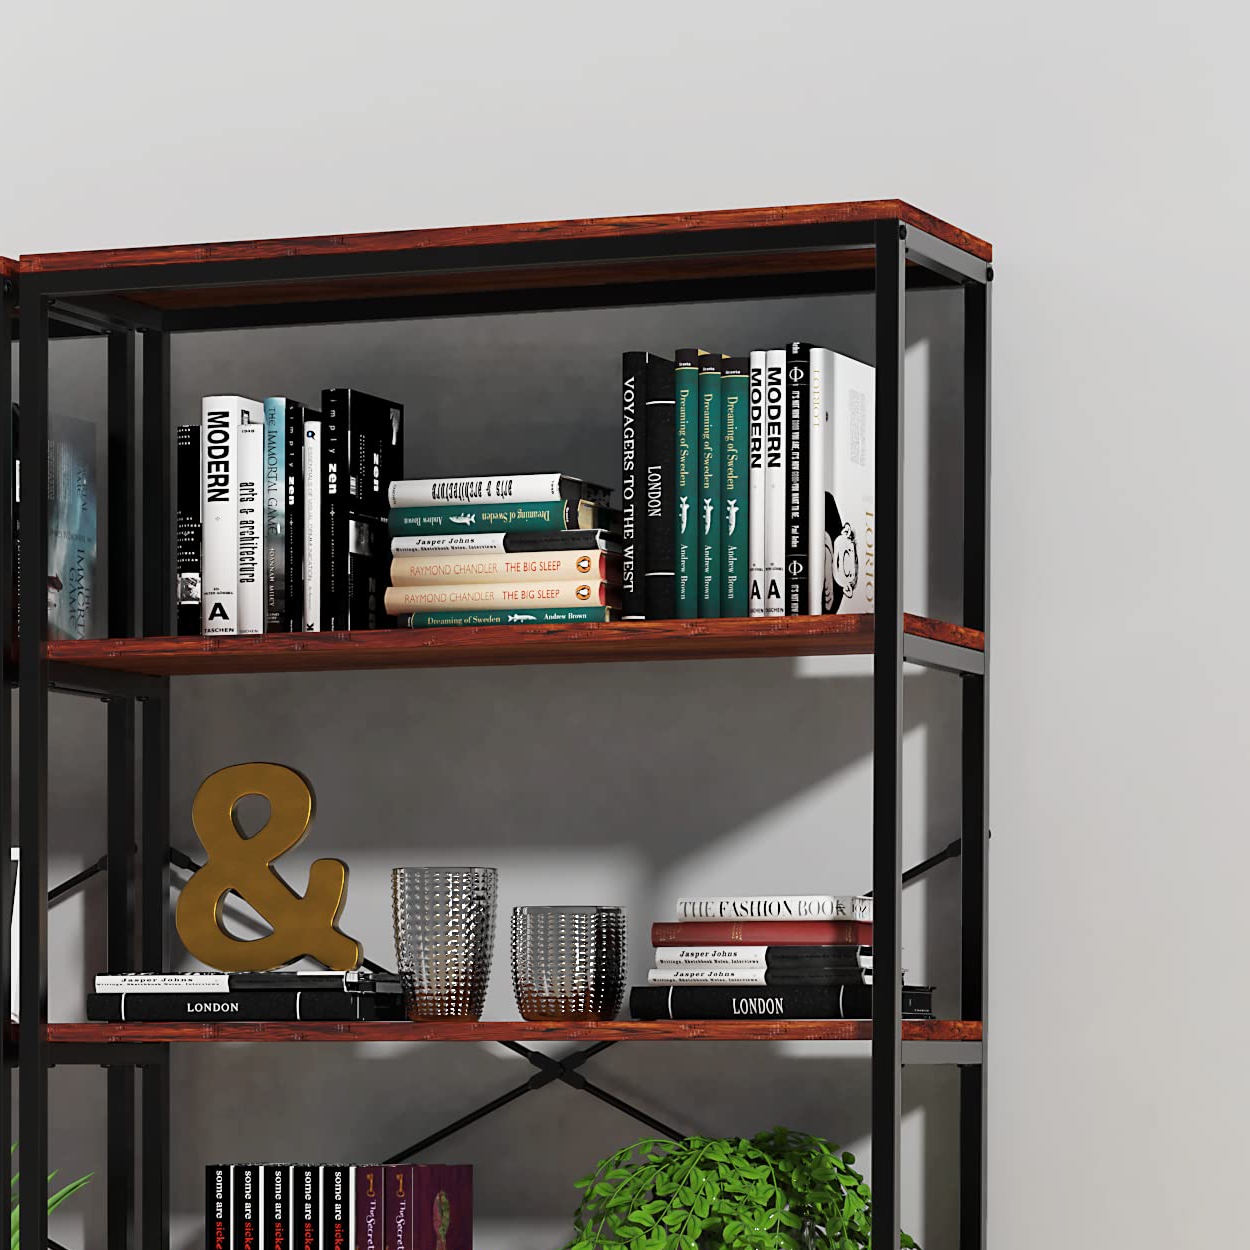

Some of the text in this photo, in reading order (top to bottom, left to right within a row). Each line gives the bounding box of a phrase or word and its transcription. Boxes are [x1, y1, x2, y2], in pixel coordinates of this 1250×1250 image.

[751, 368, 762, 469] MODERN
[767, 367, 781, 468] MODERN
[678, 389, 689, 487] Dreaming of Sweden
[724, 396, 739, 490] Dreaming of Sweden
[207, 411, 229, 503] MODERN
[267, 408, 278, 534] THE IMMORTAL GAME
[239, 482, 256, 502] arts
[287, 476, 295, 505] zen
[329, 463, 337, 494] zen
[623, 377, 634, 592] VOYAGERS TO THE WEST
[648, 466, 661, 517] LONDON
[239, 520, 259, 583] architecture
[416, 538, 445, 546] Jasper
[410, 560, 561, 576] RAYMOND CHANDLER THE BIG SLEEP
[680, 544, 689, 599] Andrew Brown
[728, 546, 737, 598] Andrew Brown
[404, 589, 560, 603] RAYMOND CHANDLER THE BIG SLEEP
[767, 579, 780, 598] A
[209, 603, 229, 620] A
[427, 617, 462, 625] Dreaming
[463, 616, 472, 624] of
[679, 900, 846, 918] THE FASHION BOOK
[679, 950, 709, 958] Jasper
[187, 1003, 239, 1012] LONDON
[733, 998, 783, 1014] LONDON
[215, 1170, 223, 1199] some
[334, 1172, 342, 1200] some
[215, 1201, 223, 1218] are
[334, 1203, 342, 1220] are
[369, 1200, 377, 1217] The
